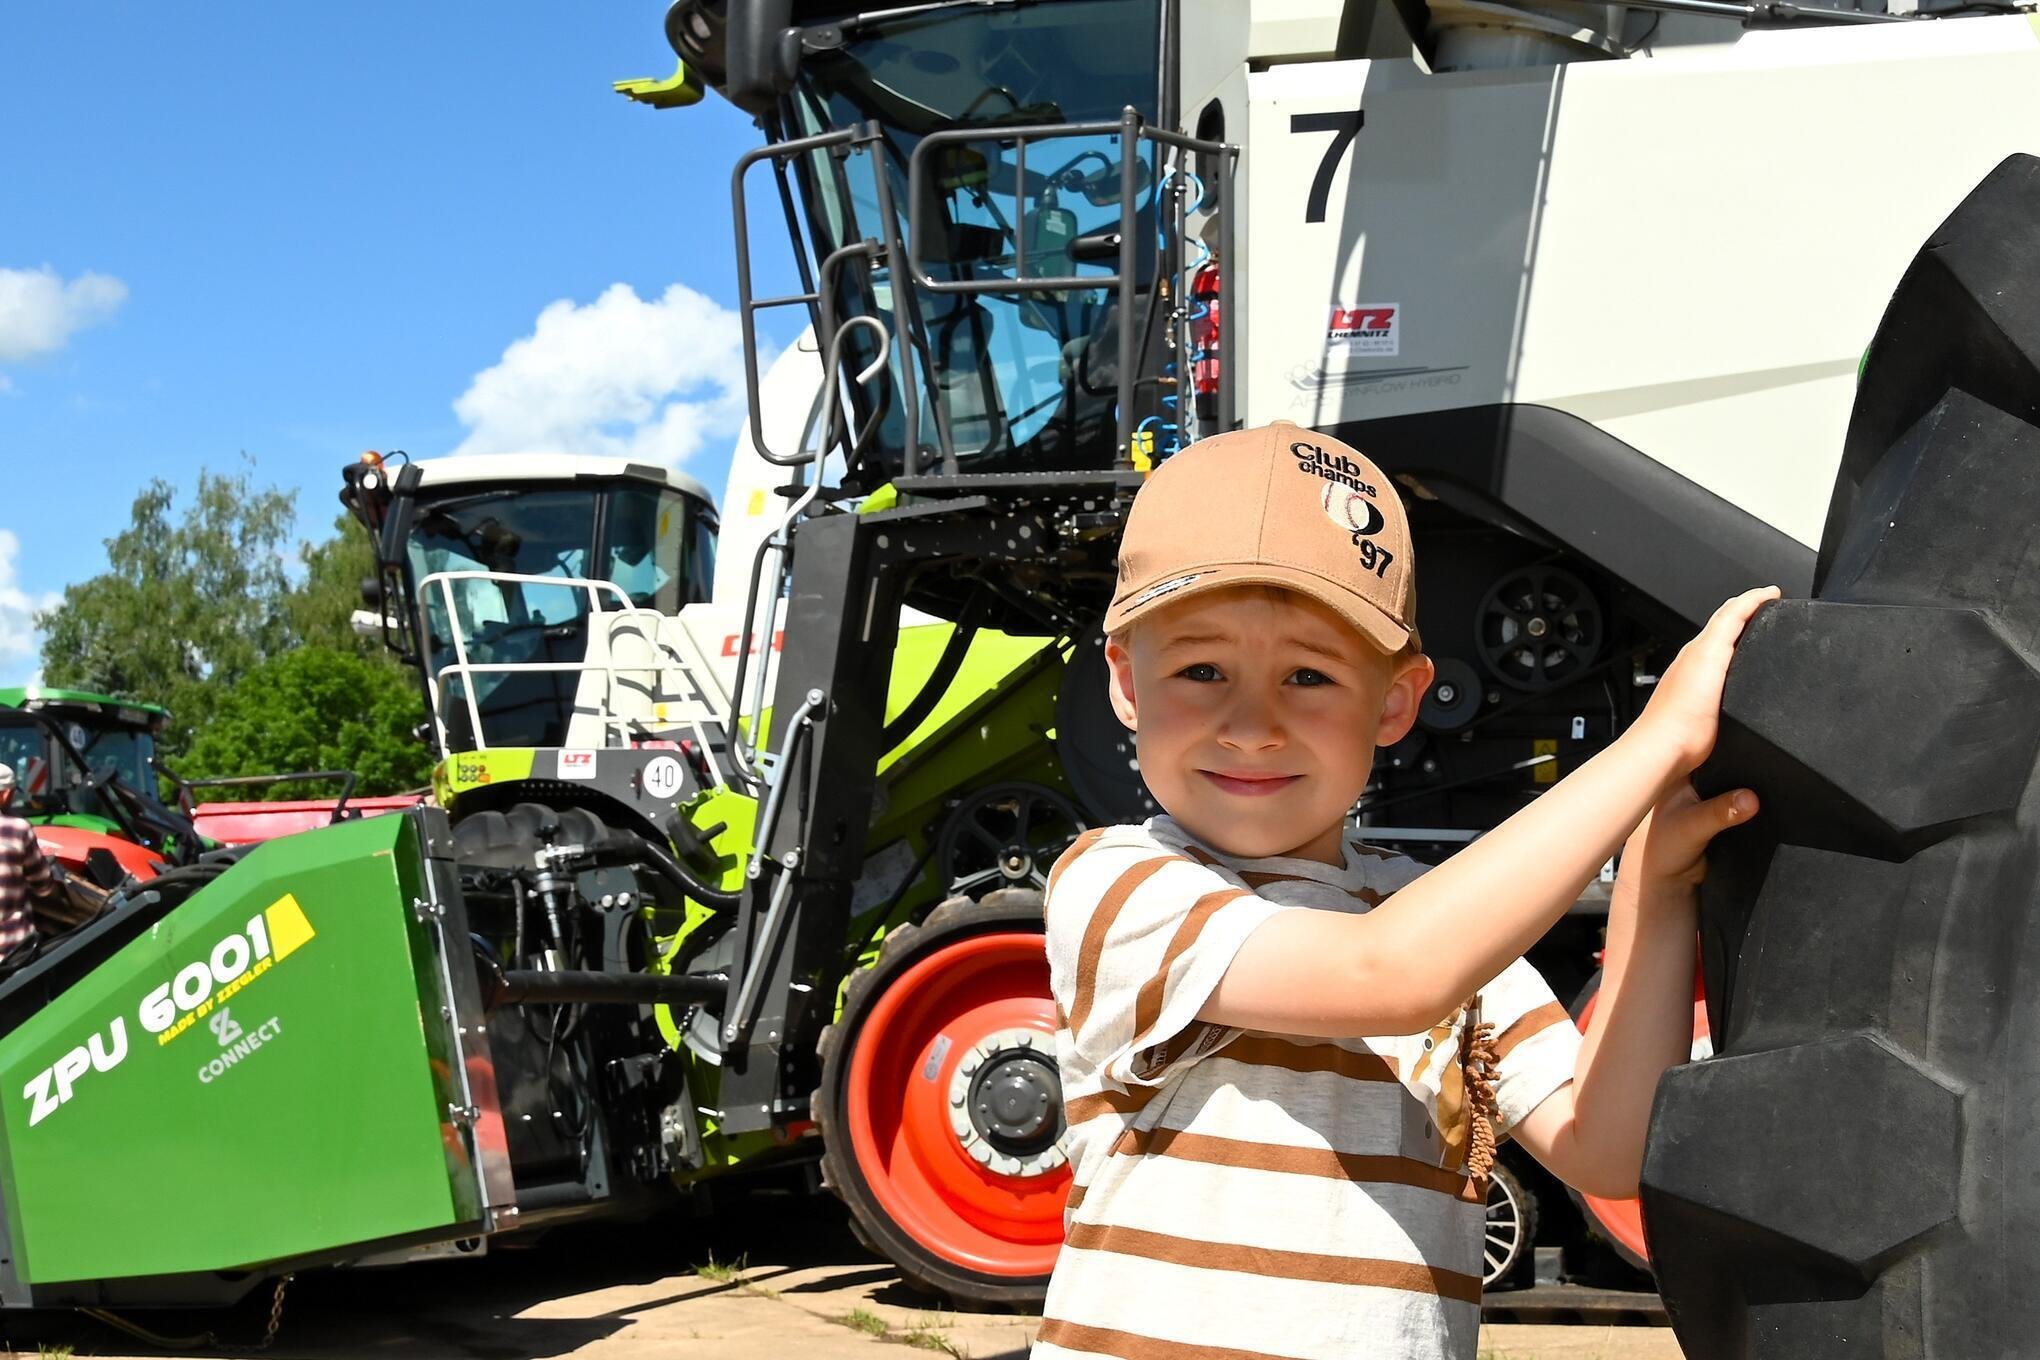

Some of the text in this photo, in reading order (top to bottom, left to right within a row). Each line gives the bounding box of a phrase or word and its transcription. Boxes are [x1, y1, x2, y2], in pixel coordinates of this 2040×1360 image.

[1289, 109, 1365, 224] 7
[1330, 308, 1394, 330] LTZ
[1290, 442, 1361, 477] Club
[1298, 460, 1377, 498] champs
[1352, 533, 1394, 579] '97
[651, 765, 674, 788] 40
[23, 913, 271, 1128] ZPU 6001
[158, 1011, 196, 1046] MADE
[196, 998, 214, 1018] BY
[198, 1016, 282, 1083] CONNECT
